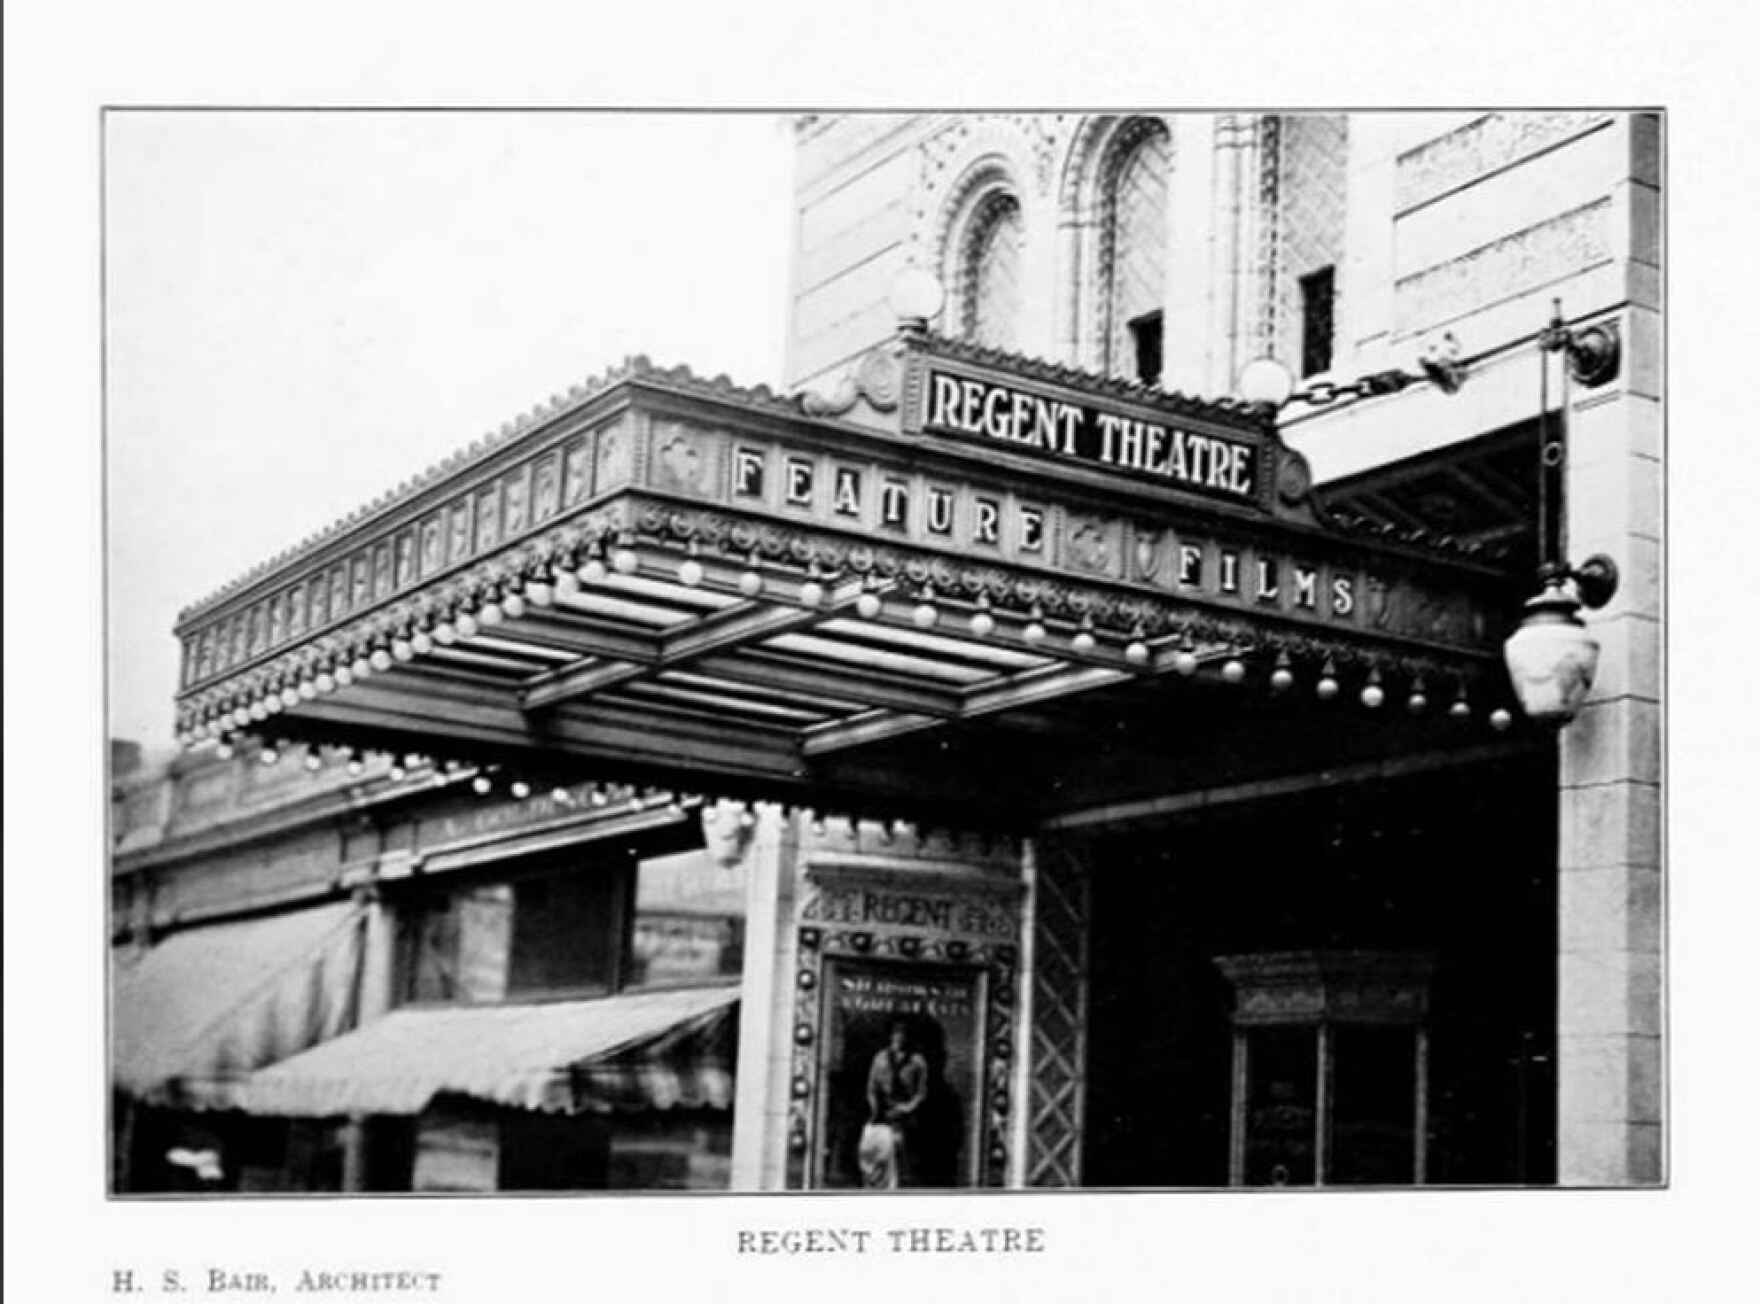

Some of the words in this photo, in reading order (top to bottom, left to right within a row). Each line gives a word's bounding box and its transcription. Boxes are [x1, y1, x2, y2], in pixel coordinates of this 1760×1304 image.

[932, 373, 1084, 455] REGENT
[1097, 413, 1252, 494] THEATRE
[734, 446, 1042, 553] FEATURE
[1179, 544, 1353, 616] FILMS
